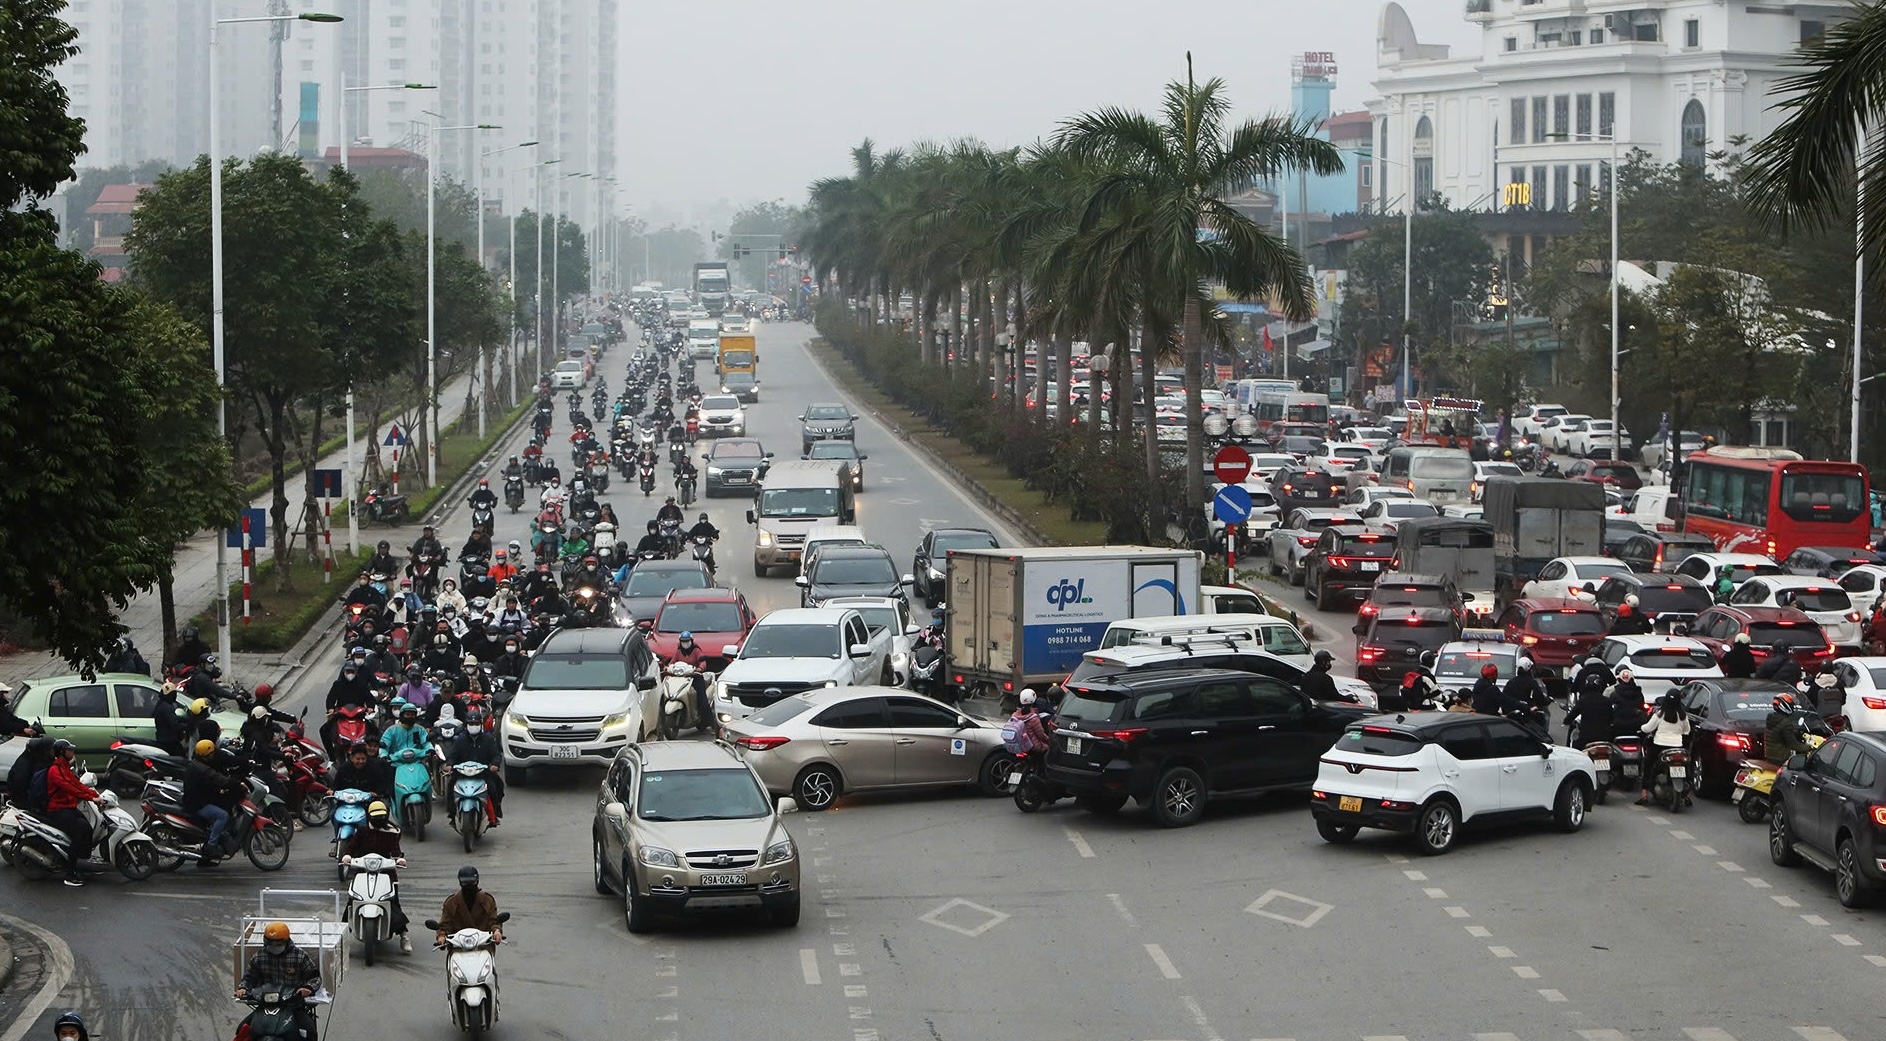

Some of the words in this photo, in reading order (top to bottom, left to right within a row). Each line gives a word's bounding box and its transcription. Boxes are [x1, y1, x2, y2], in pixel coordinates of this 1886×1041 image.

[1304, 51, 1335, 63] HOTEL
[1504, 182, 1530, 206] CT1B
[1047, 636, 1064, 645] 0988
[1079, 635, 1092, 643] 068
